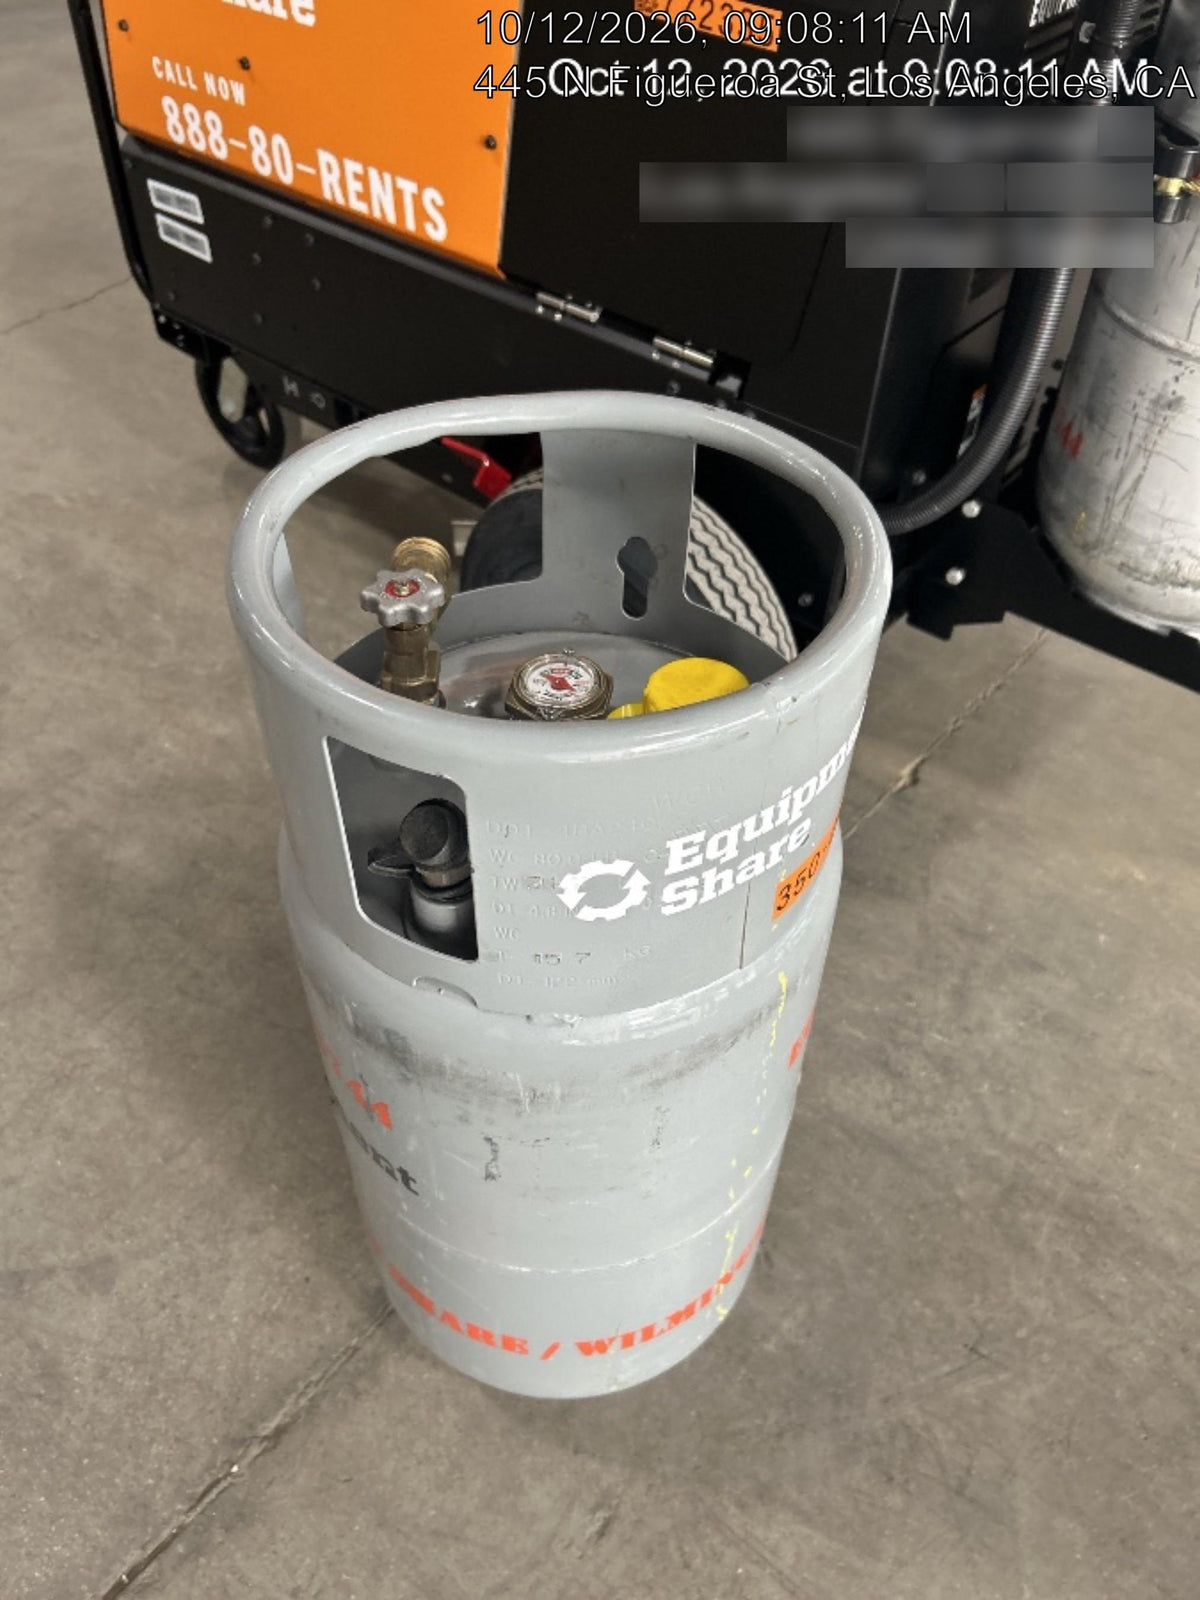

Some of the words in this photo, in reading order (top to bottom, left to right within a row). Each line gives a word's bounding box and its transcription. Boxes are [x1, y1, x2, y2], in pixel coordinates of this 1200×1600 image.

[152, 55, 198, 91] CALL
[203, 71, 245, 106] NOW
[161, 96, 449, 242] 888-80-RENTS
[661, 817, 812, 916] Share
